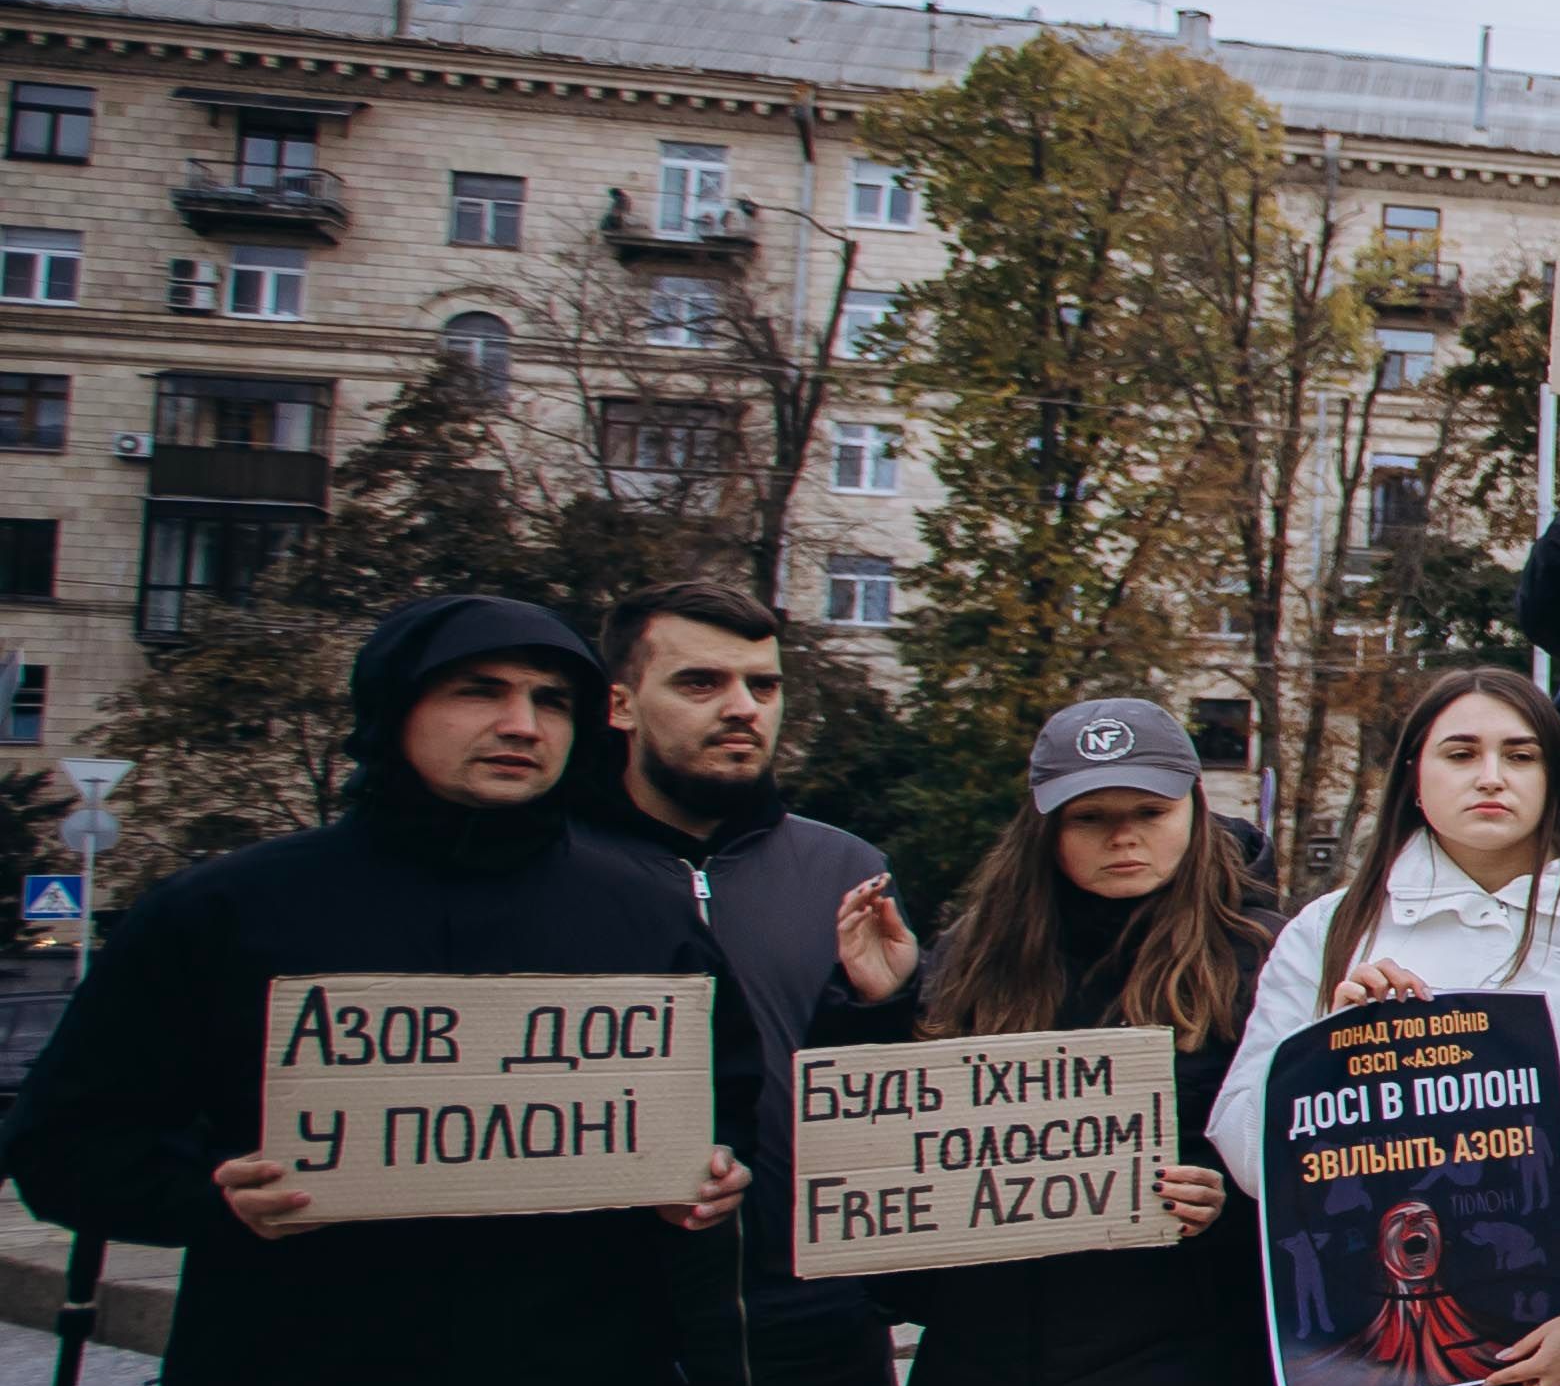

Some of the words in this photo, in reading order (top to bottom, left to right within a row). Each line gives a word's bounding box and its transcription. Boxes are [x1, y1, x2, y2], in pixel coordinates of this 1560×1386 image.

[282, 985, 462, 1066] Азов
[502, 995, 675, 1072] досі
[1330, 1021, 1390, 1050] ПОНАД
[1394, 1020, 1426, 1040] 700
[1430, 1010, 1489, 1036] ВОЇНІВ
[1349, 1051, 1397, 1076] ОЗСП
[1402, 1043, 1474, 1068] «АЗОВ»
[802, 1059, 944, 1124] Будь
[963, 1046, 1114, 1106] їхнім
[1288, 1091, 1370, 1140] ДОСІ
[1379, 1083, 1403, 1119] В
[1414, 1067, 1541, 1116] ПОЛОНІ
[384, 1088, 638, 1166] полоні
[914, 1092, 1163, 1173] голосом!
[1302, 1136, 1446, 1183] ЗВІЛЬНІТЬ
[1453, 1126, 1535, 1163] АЗОВ!
